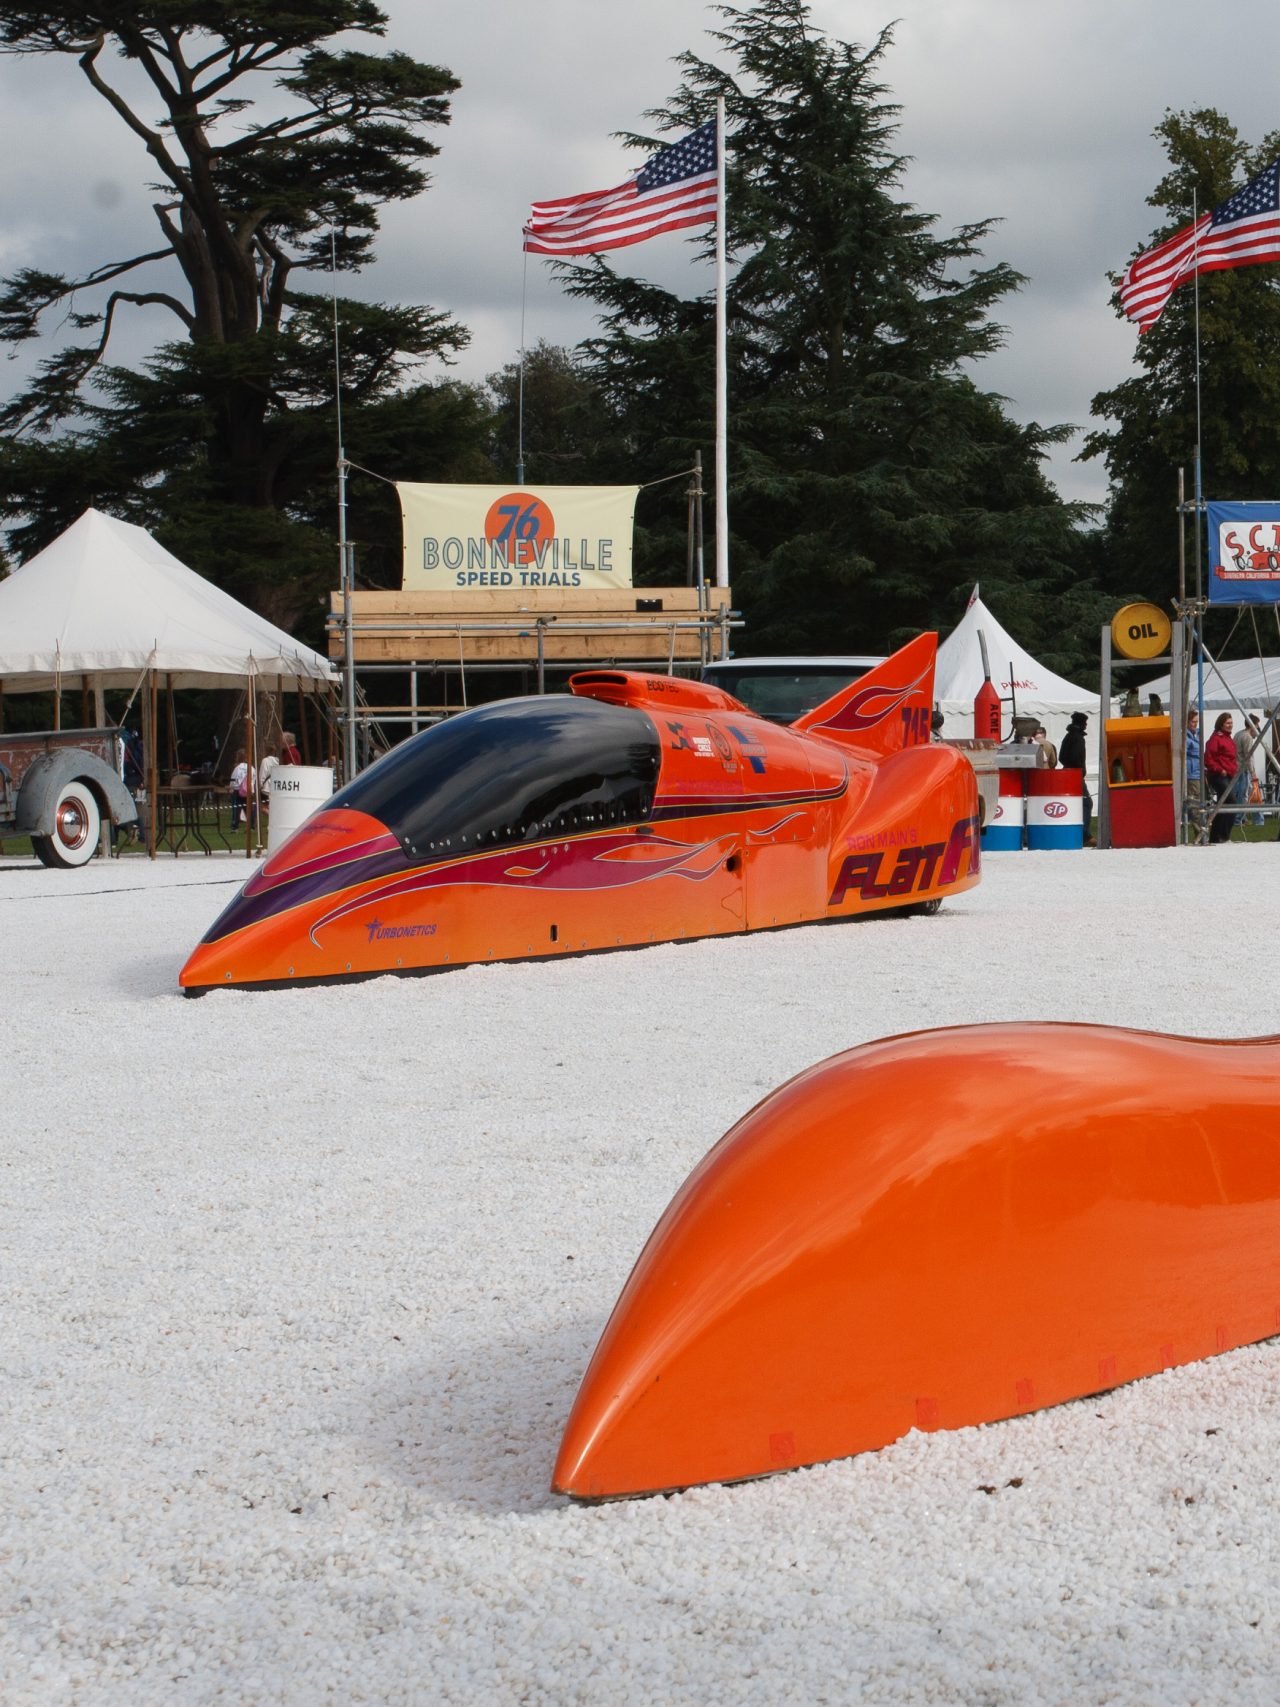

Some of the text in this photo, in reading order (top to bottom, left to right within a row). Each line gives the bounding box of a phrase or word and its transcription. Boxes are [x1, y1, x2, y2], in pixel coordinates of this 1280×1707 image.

[496, 502, 541, 543] 76
[423, 537, 613, 571] BONNEVILLE
[456, 572, 581, 587] SPEED TRIALS
[1128, 623, 1158, 641] OIL
[901, 707, 929, 749] 715
[989, 703, 999, 735] ACME
[273, 780, 300, 791] TRASH
[1046, 803, 1066, 816] STP
[846, 828, 918, 851] RON MAIN'S
[365, 917, 437, 944] TURBONETICS
